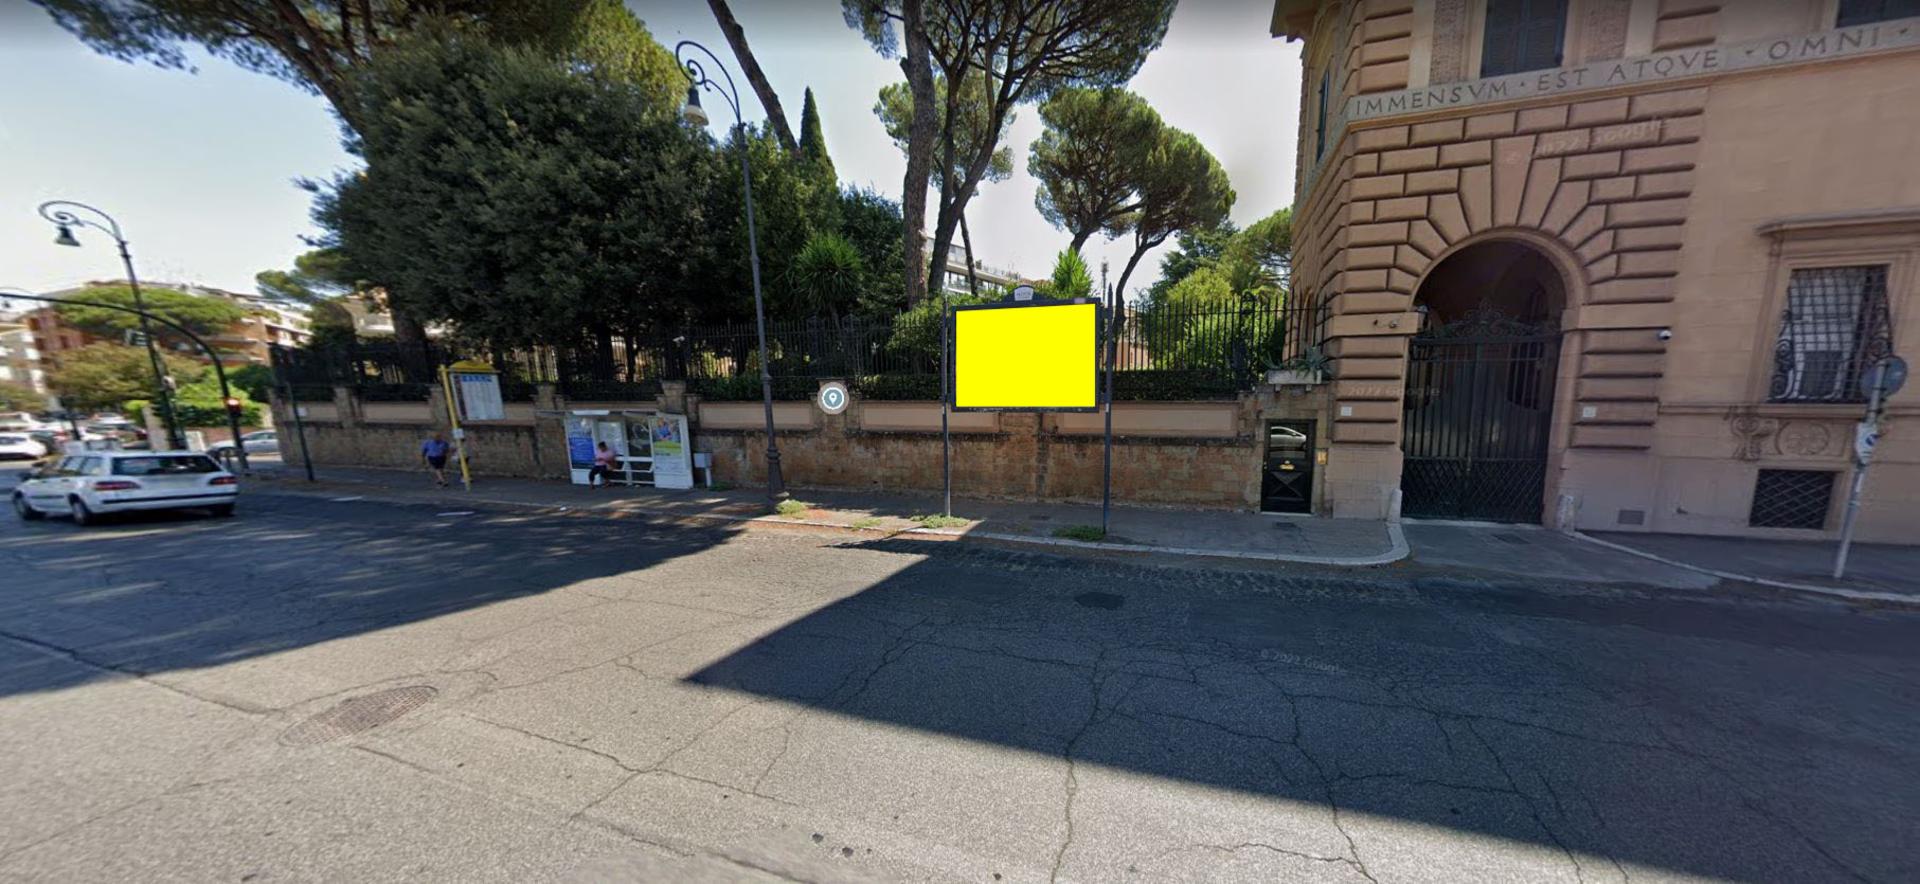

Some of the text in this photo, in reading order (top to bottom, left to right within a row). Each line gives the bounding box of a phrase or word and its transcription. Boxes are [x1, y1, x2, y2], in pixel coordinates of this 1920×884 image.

[1355, 27, 1880, 116] IMMENSVM EST ATQVE OMNI
